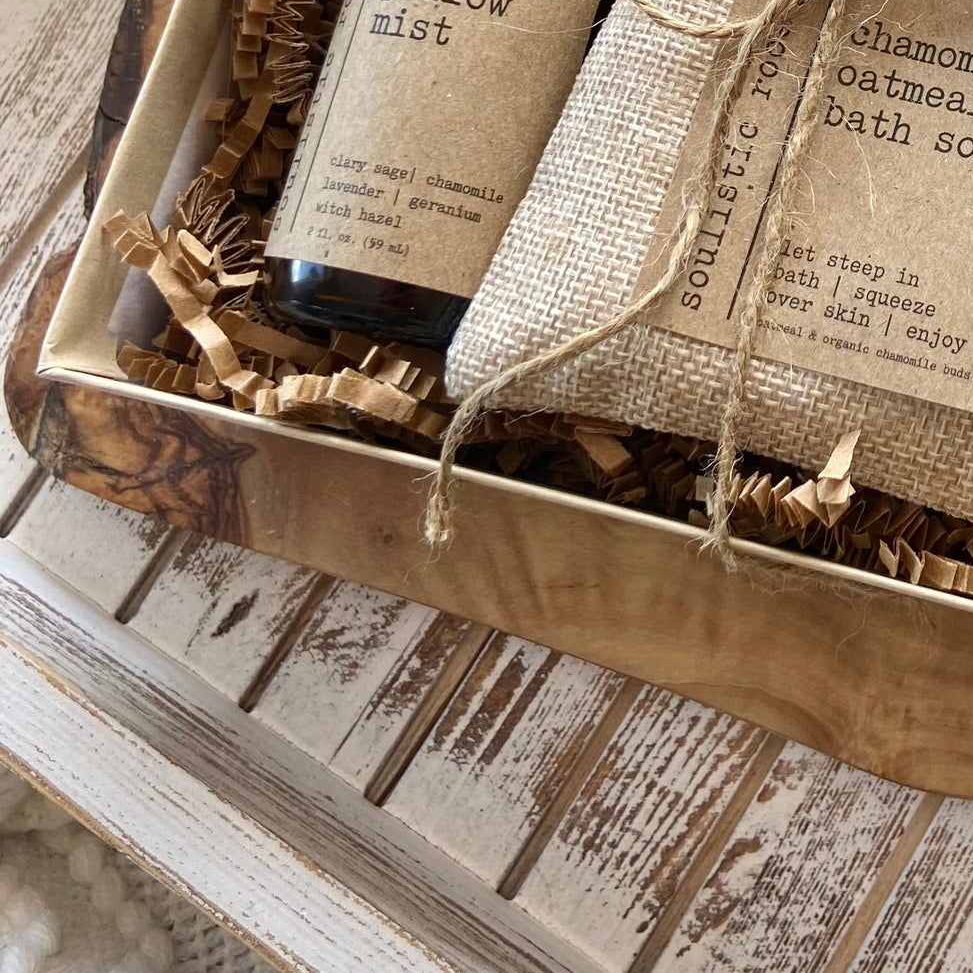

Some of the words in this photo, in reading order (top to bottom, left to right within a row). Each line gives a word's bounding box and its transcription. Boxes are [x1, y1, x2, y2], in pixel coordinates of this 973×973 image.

[369, 8, 453, 45] mist
[824, 95, 911, 145] bath
[331, 154, 366, 172] clary
[426, 174, 504, 204] chamomile
[681, 121, 758, 311] soulistic
[751, 26, 791, 100] roo
[315, 201, 351, 218] witch
[358, 207, 402, 228] hazel
[322, 177, 384, 199] lavender
[409, 196, 482, 223] geranium
[779, 239, 816, 262] let
[827, 254, 885, 282] steep
[896, 267, 920, 288] in
[774, 263, 819, 289] bath
[854, 287, 936, 317] squeeze
[766, 290, 813, 312] over
[824, 303, 870, 328] skin
[906, 326, 968, 354] enjoy
[808, 329, 817, 341] &
[822, 335, 870, 354] organic
[876, 348, 937, 372] chamomile
[943, 363, 971, 380] buds
